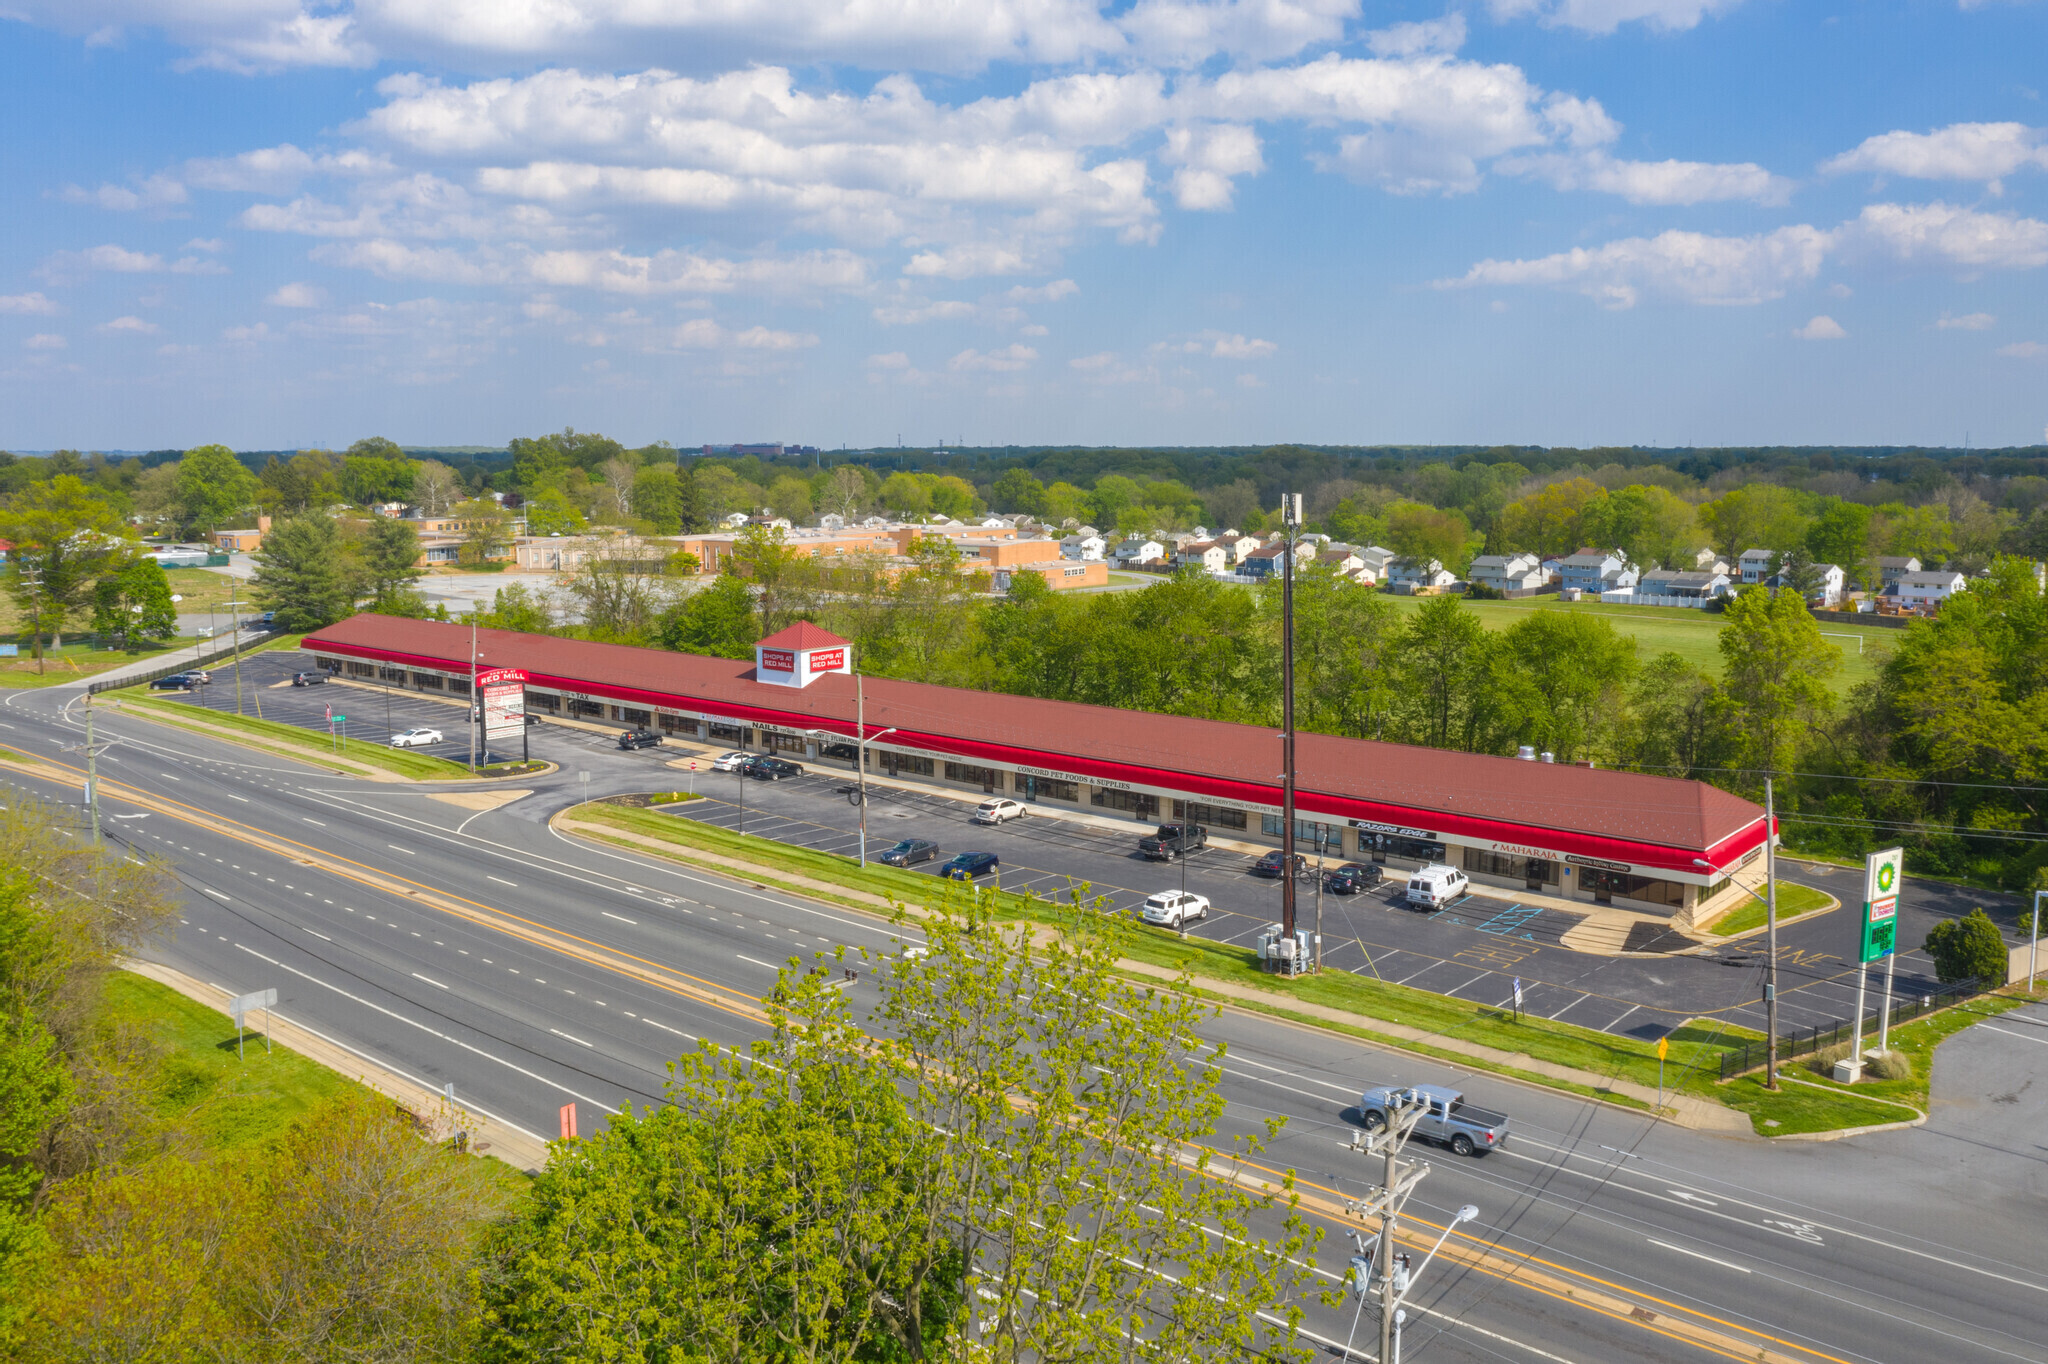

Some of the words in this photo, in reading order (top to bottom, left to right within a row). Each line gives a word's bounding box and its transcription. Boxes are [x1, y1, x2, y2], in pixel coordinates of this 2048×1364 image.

[763, 652, 784, 661] SHOPS
[811, 653, 834, 662] SHOPS
[764, 659, 777, 668] RED
[777, 661, 792, 669] MILL
[812, 661, 826, 669] RED
[827, 659, 842, 667] MILL
[481, 675, 500, 685] RED
[576, 693, 589, 701] TAX
[752, 721, 778, 732] NAILS
[830, 734, 848, 744] SYLVAN
[1017, 765, 1050, 777] CONCORD
[1050, 771, 1063, 779] PET
[1065, 773, 1088, 783] FOODS
[1096, 778, 1131, 790] SUPPLIES
[1213, 798, 1244, 809] EVERYTHING
[1245, 803, 1260, 811] YOUR
[1356, 821, 1398, 833] RAZORS
[1399, 828, 1428, 838] EDGE
[1500, 844, 1558, 860] MAHARAJA
